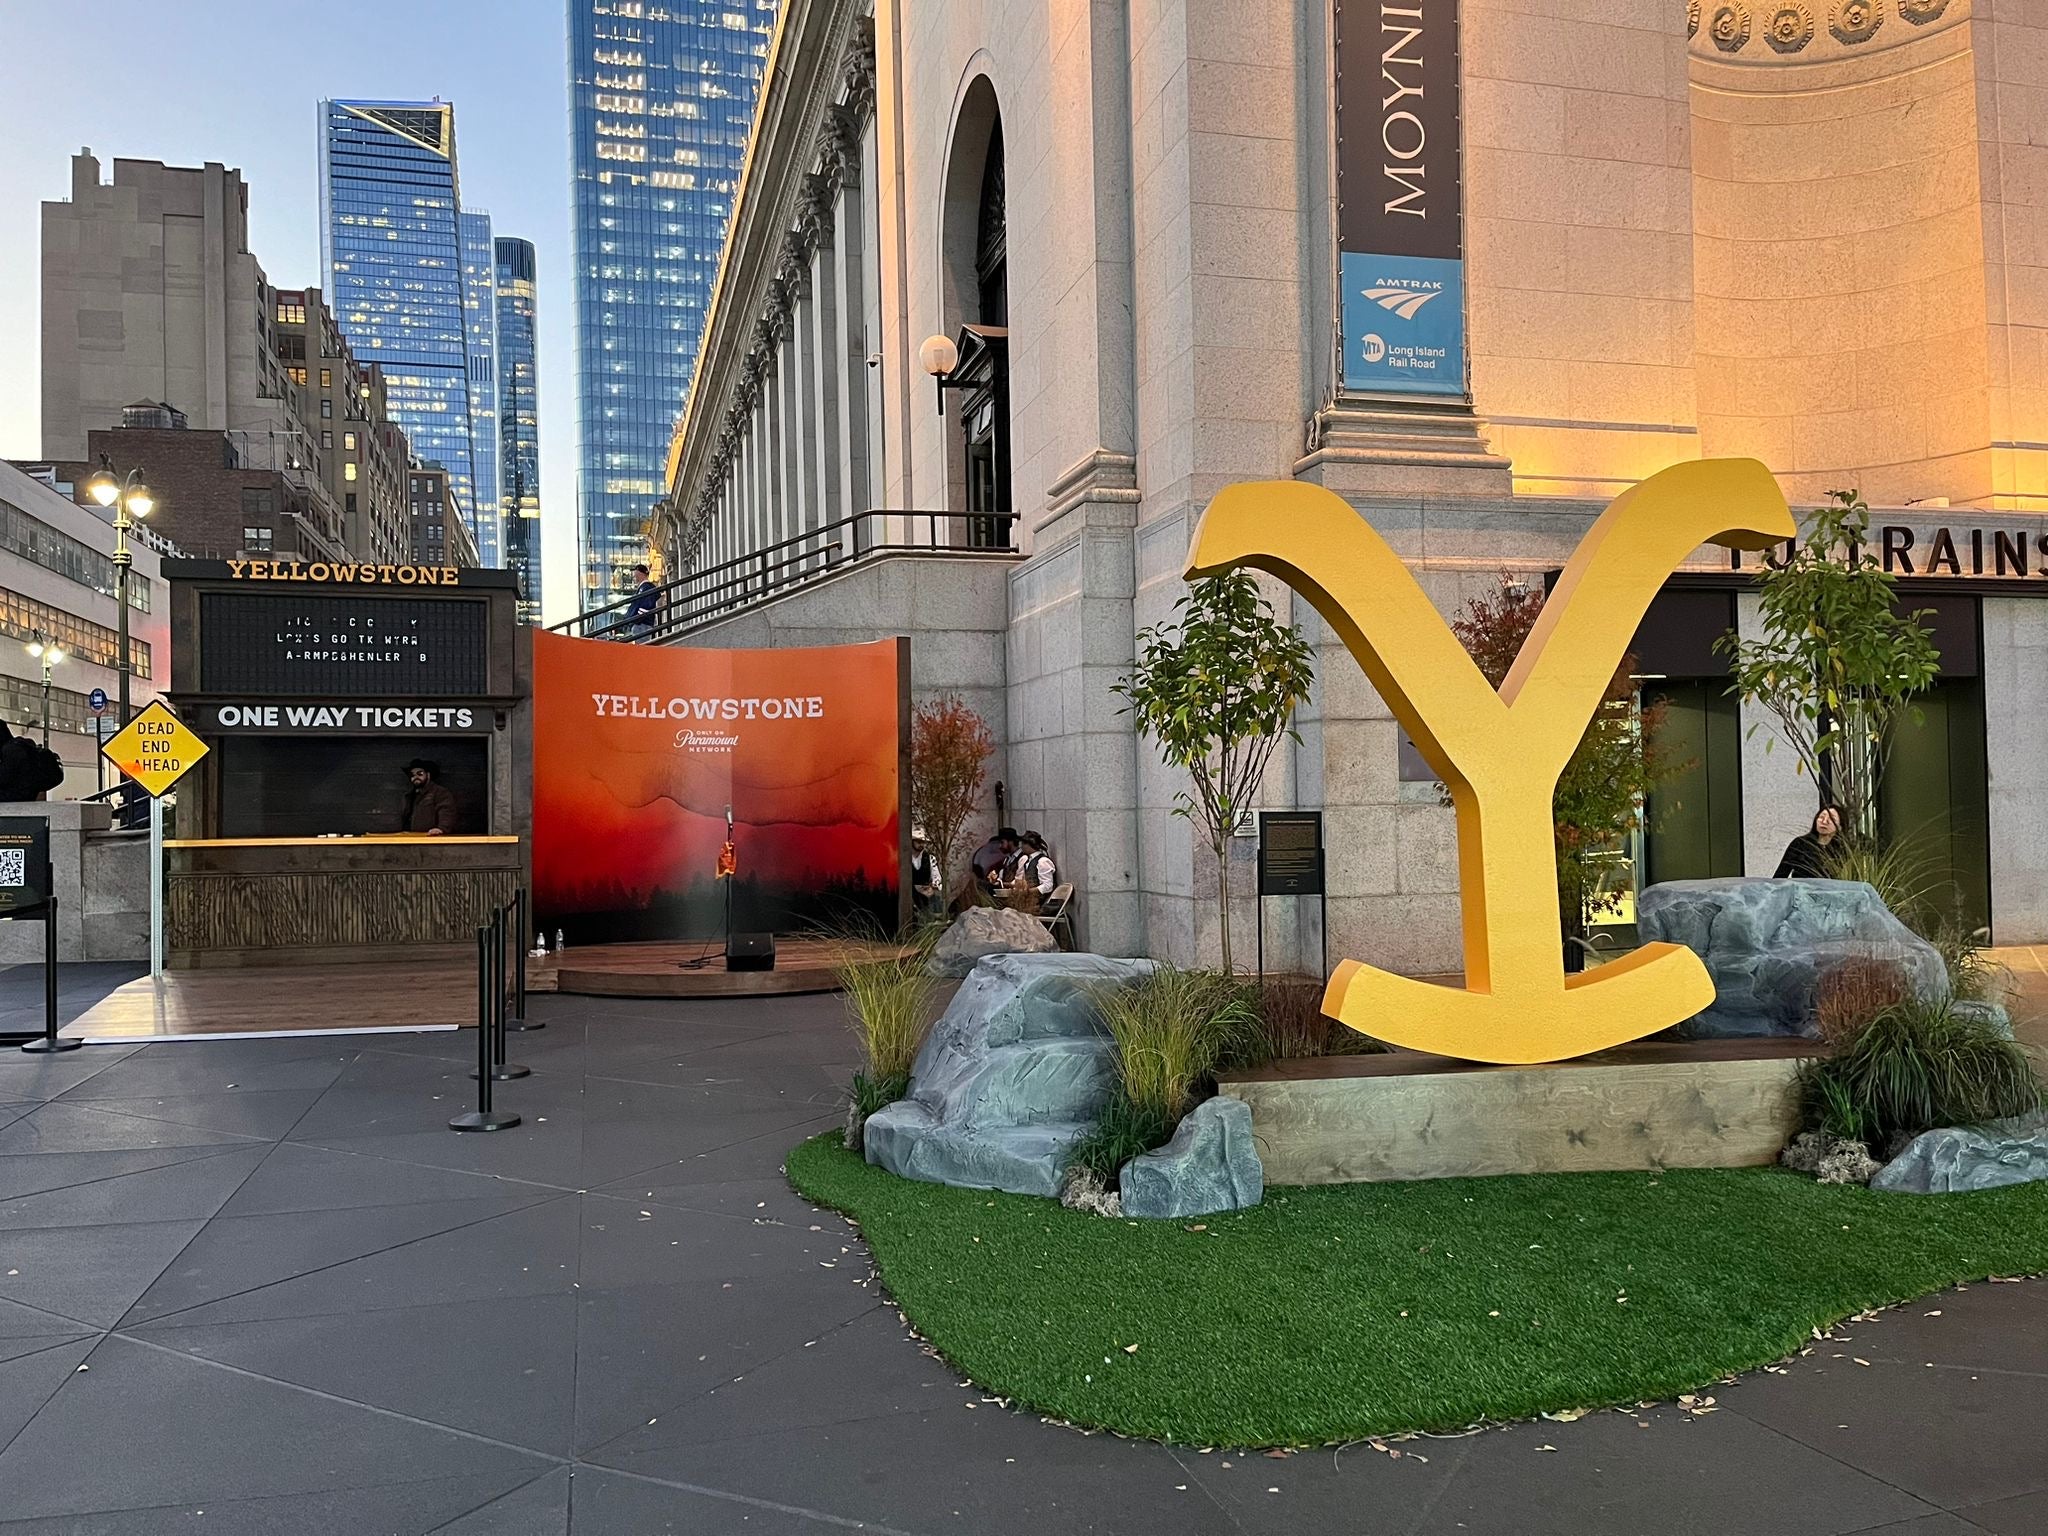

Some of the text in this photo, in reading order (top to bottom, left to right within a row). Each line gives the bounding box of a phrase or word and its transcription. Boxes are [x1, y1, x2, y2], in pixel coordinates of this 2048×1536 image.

[1375, 278, 1442, 289] AMTRAK
[1388, 345, 1445, 357] Long Island
[1388, 357, 1436, 369] Rail Road
[227, 560, 459, 585] YELLOWSTONE
[331, 634, 347, 644] GO
[592, 694, 824, 720] YELLOWSTONE
[218, 706, 473, 728] ONE WAY TICKETS
[138, 722, 175, 734] DEAD
[673, 728, 738, 748] Paramount
[142, 741, 170, 752] END
